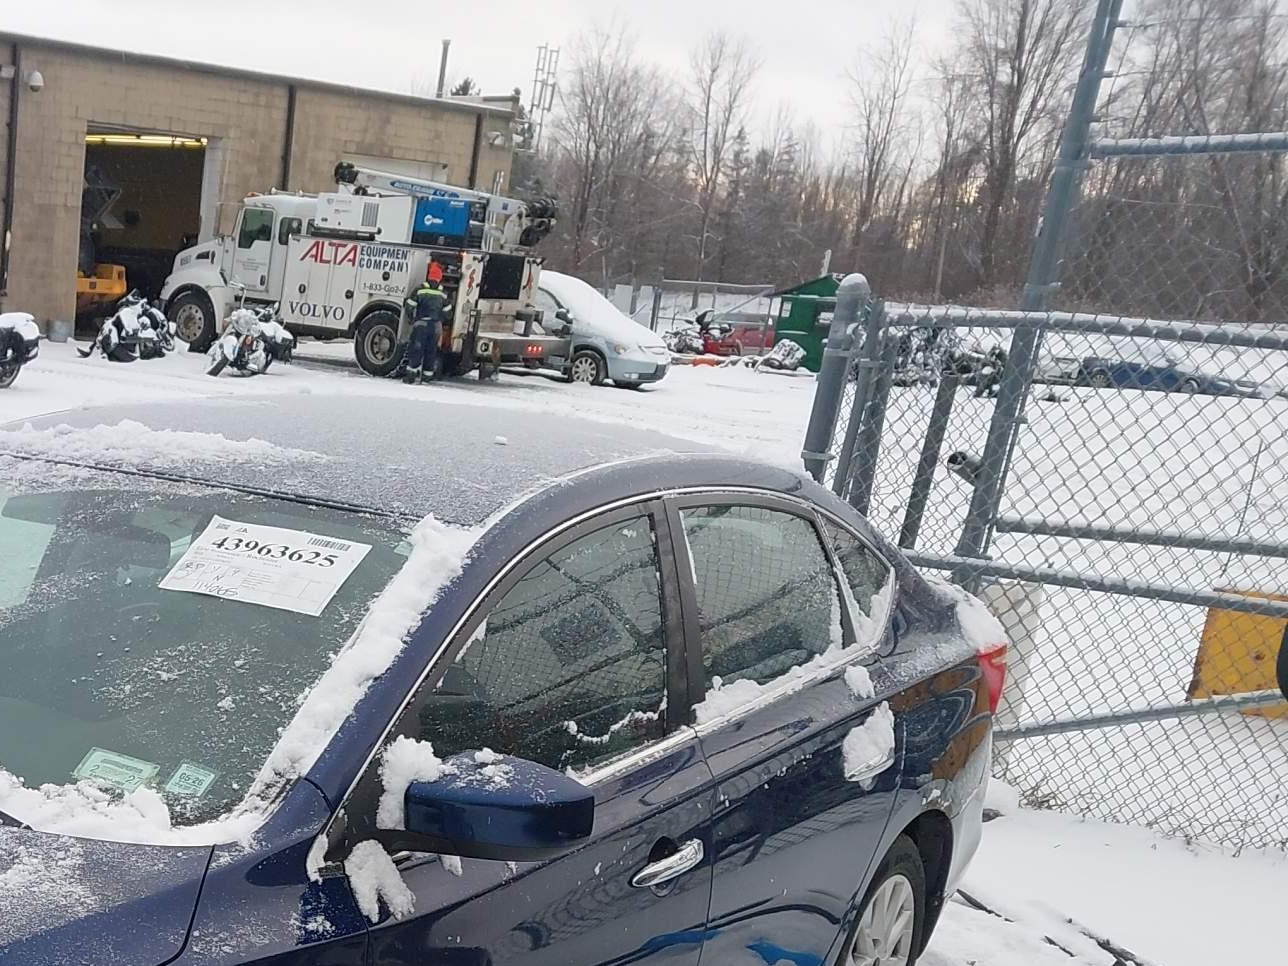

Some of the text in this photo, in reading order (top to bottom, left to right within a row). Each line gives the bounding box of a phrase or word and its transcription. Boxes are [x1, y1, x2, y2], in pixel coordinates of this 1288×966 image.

[300, 240, 359, 267] ALTA
[360, 245, 410, 260] EQUIPMEN
[289, 301, 345, 321] VOLVO
[212, 536, 339, 567] 43963625
